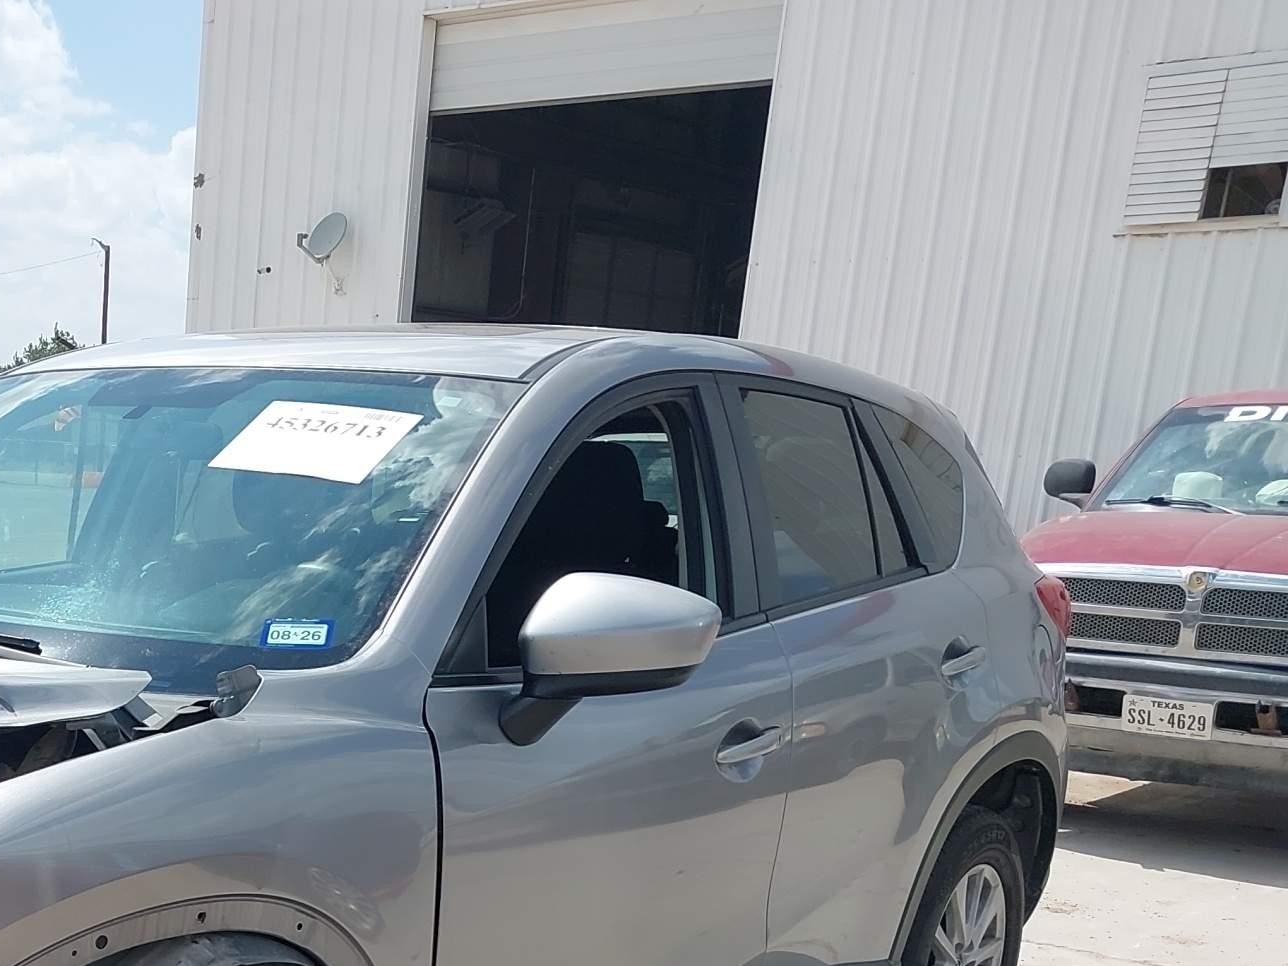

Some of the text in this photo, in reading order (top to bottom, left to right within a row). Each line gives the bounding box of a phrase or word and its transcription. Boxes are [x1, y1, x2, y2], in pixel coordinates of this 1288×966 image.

[267, 416, 386, 438] 45326713
[270, 630, 322, 640] 08 26
[1151, 700, 1184, 711] TEXAS
[1128, 708, 1155, 726] SSL
[1167, 712, 1206, 732] 4629
